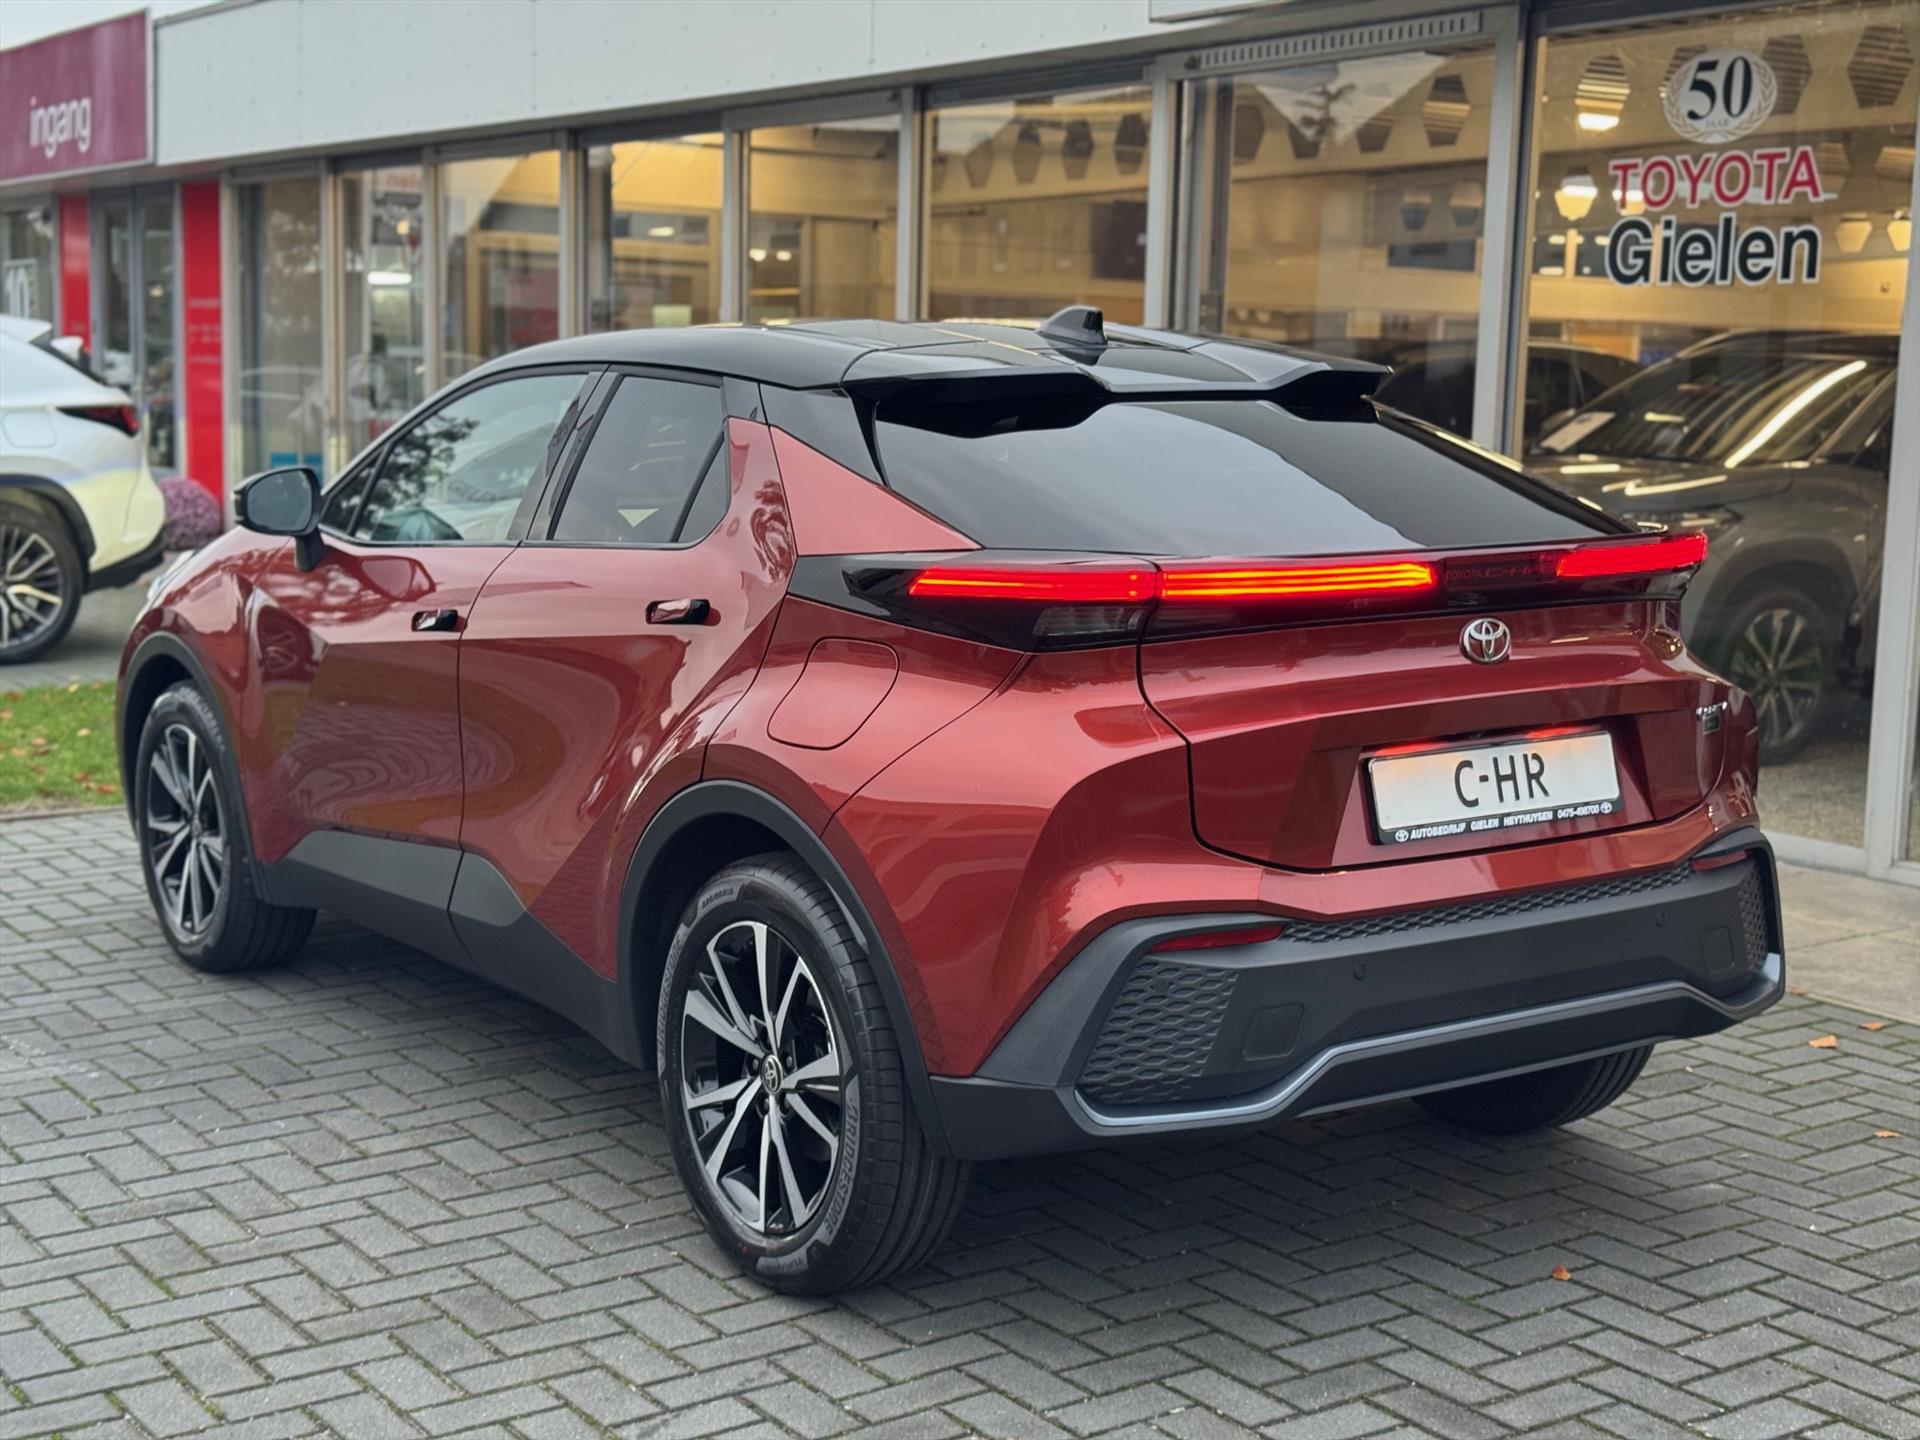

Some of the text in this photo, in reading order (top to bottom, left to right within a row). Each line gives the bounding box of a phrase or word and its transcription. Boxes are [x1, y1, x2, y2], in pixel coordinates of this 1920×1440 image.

[1687, 56, 1753, 120] 50
[30, 96, 91, 158] ingang
[1609, 147, 1824, 211] TOYOTA
[1606, 213, 1821, 287] Gielen
[1455, 753, 1549, 807] C-HR
[1410, 822, 1466, 840] AUTOBEDRIJF
[1471, 818, 1499, 831] GIELEN
